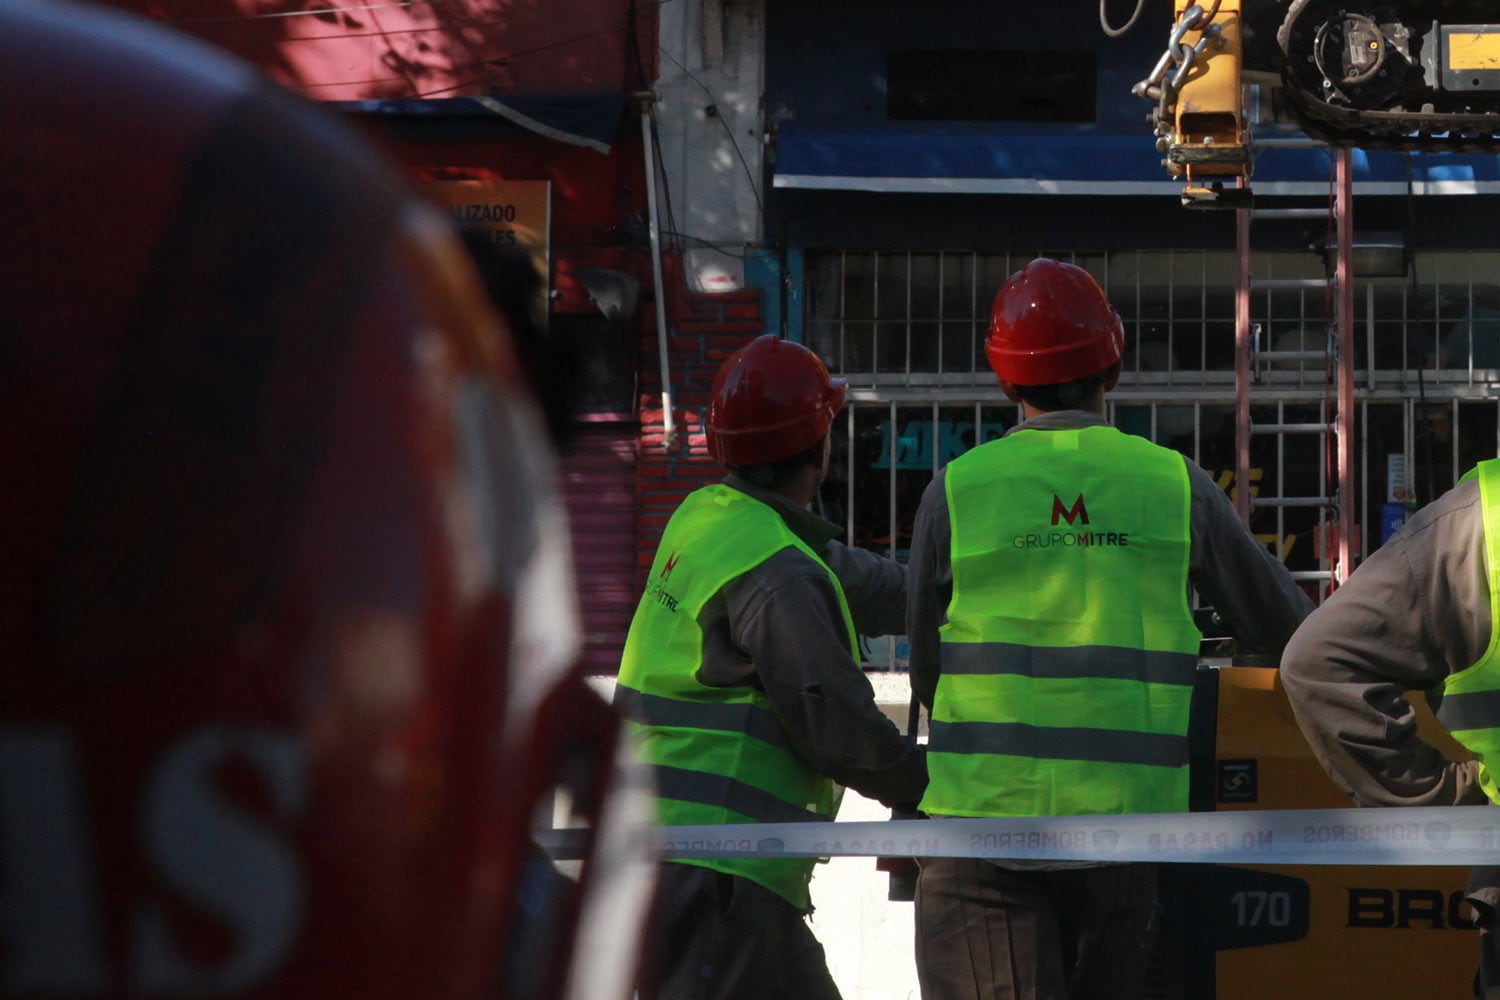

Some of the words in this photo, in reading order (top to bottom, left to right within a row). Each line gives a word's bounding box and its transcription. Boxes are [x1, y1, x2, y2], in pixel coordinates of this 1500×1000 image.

[1051, 493, 1089, 526] M
[1013, 531, 1129, 549] GRUPOMITRE
[1231, 891, 1291, 928] 170
